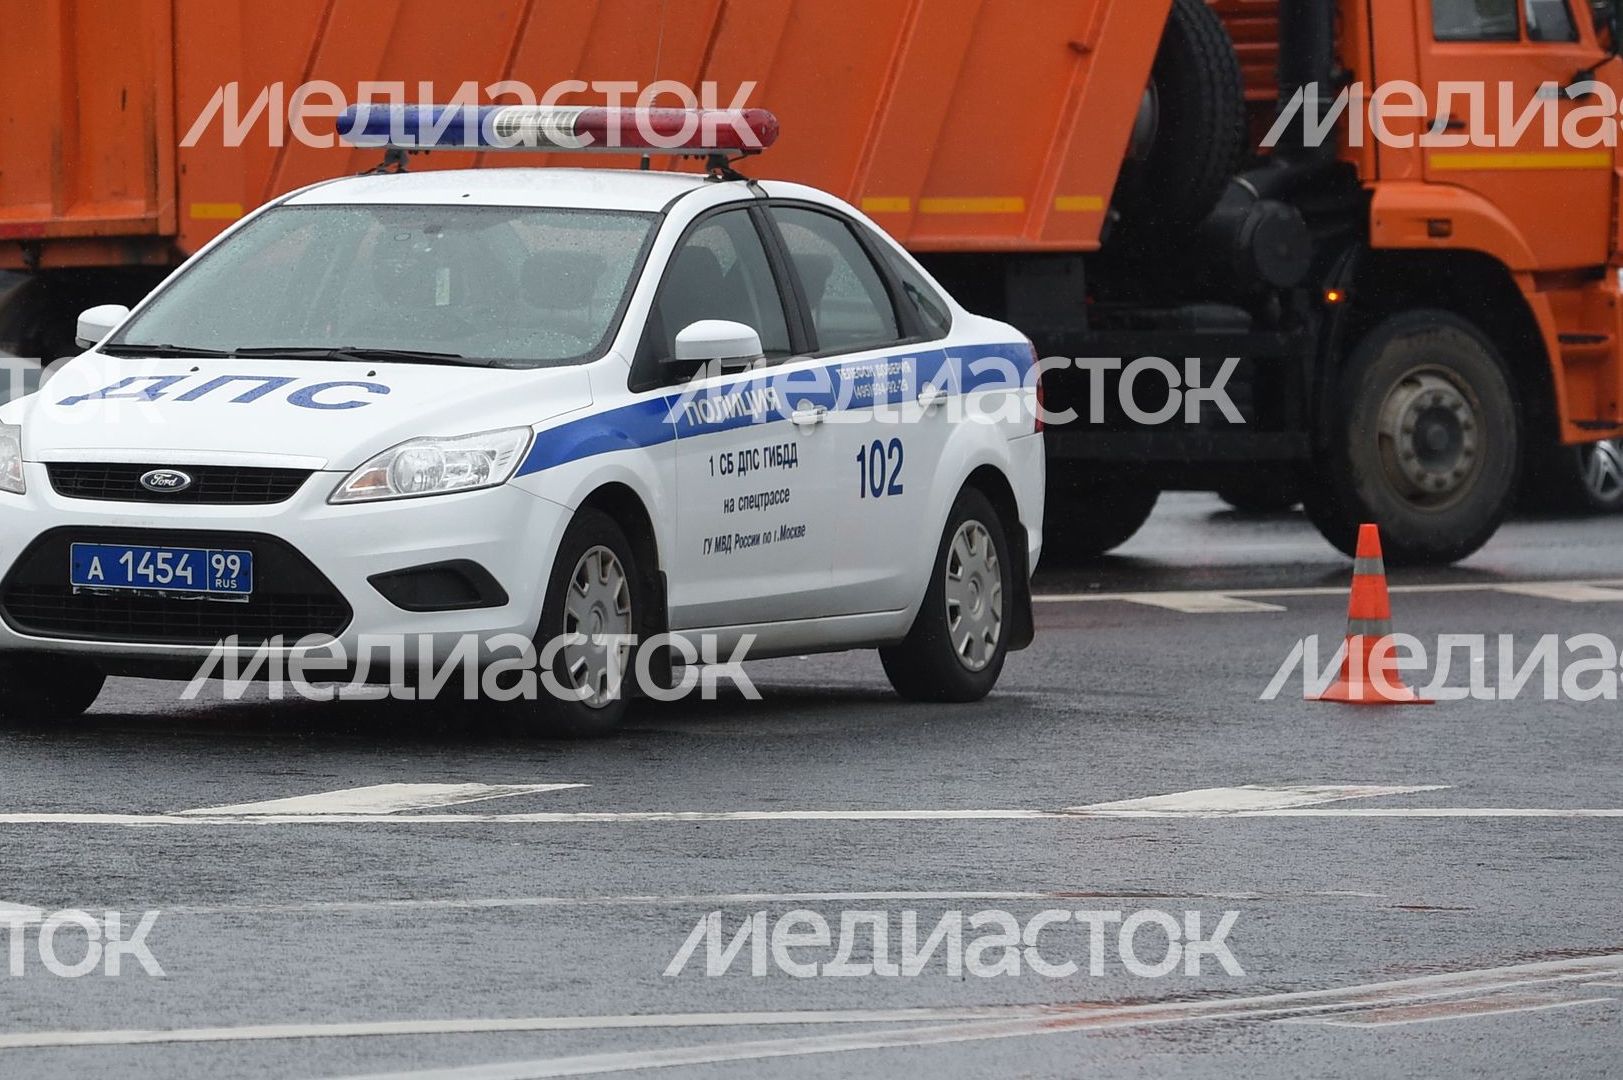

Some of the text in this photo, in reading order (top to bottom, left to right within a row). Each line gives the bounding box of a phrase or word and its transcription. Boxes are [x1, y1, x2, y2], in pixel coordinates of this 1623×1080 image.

[55, 375, 391, 410] ДПС
[683, 386, 782, 427] ПОЛИЦИЯ
[709, 442, 799, 477] 1 СБ ДПС ГИБДД
[856, 437, 904, 499] 102
[150, 472, 177, 488] Ford
[723, 487, 790, 514] на спецтрассе
[703, 537, 713, 555] ГУ
[714, 533, 731, 554] МВД
[734, 531, 761, 550] России
[762, 530, 772, 545] по
[119, 550, 193, 585] 1454
[211, 553, 241, 578] 99
[215, 578, 237, 589] RUS
